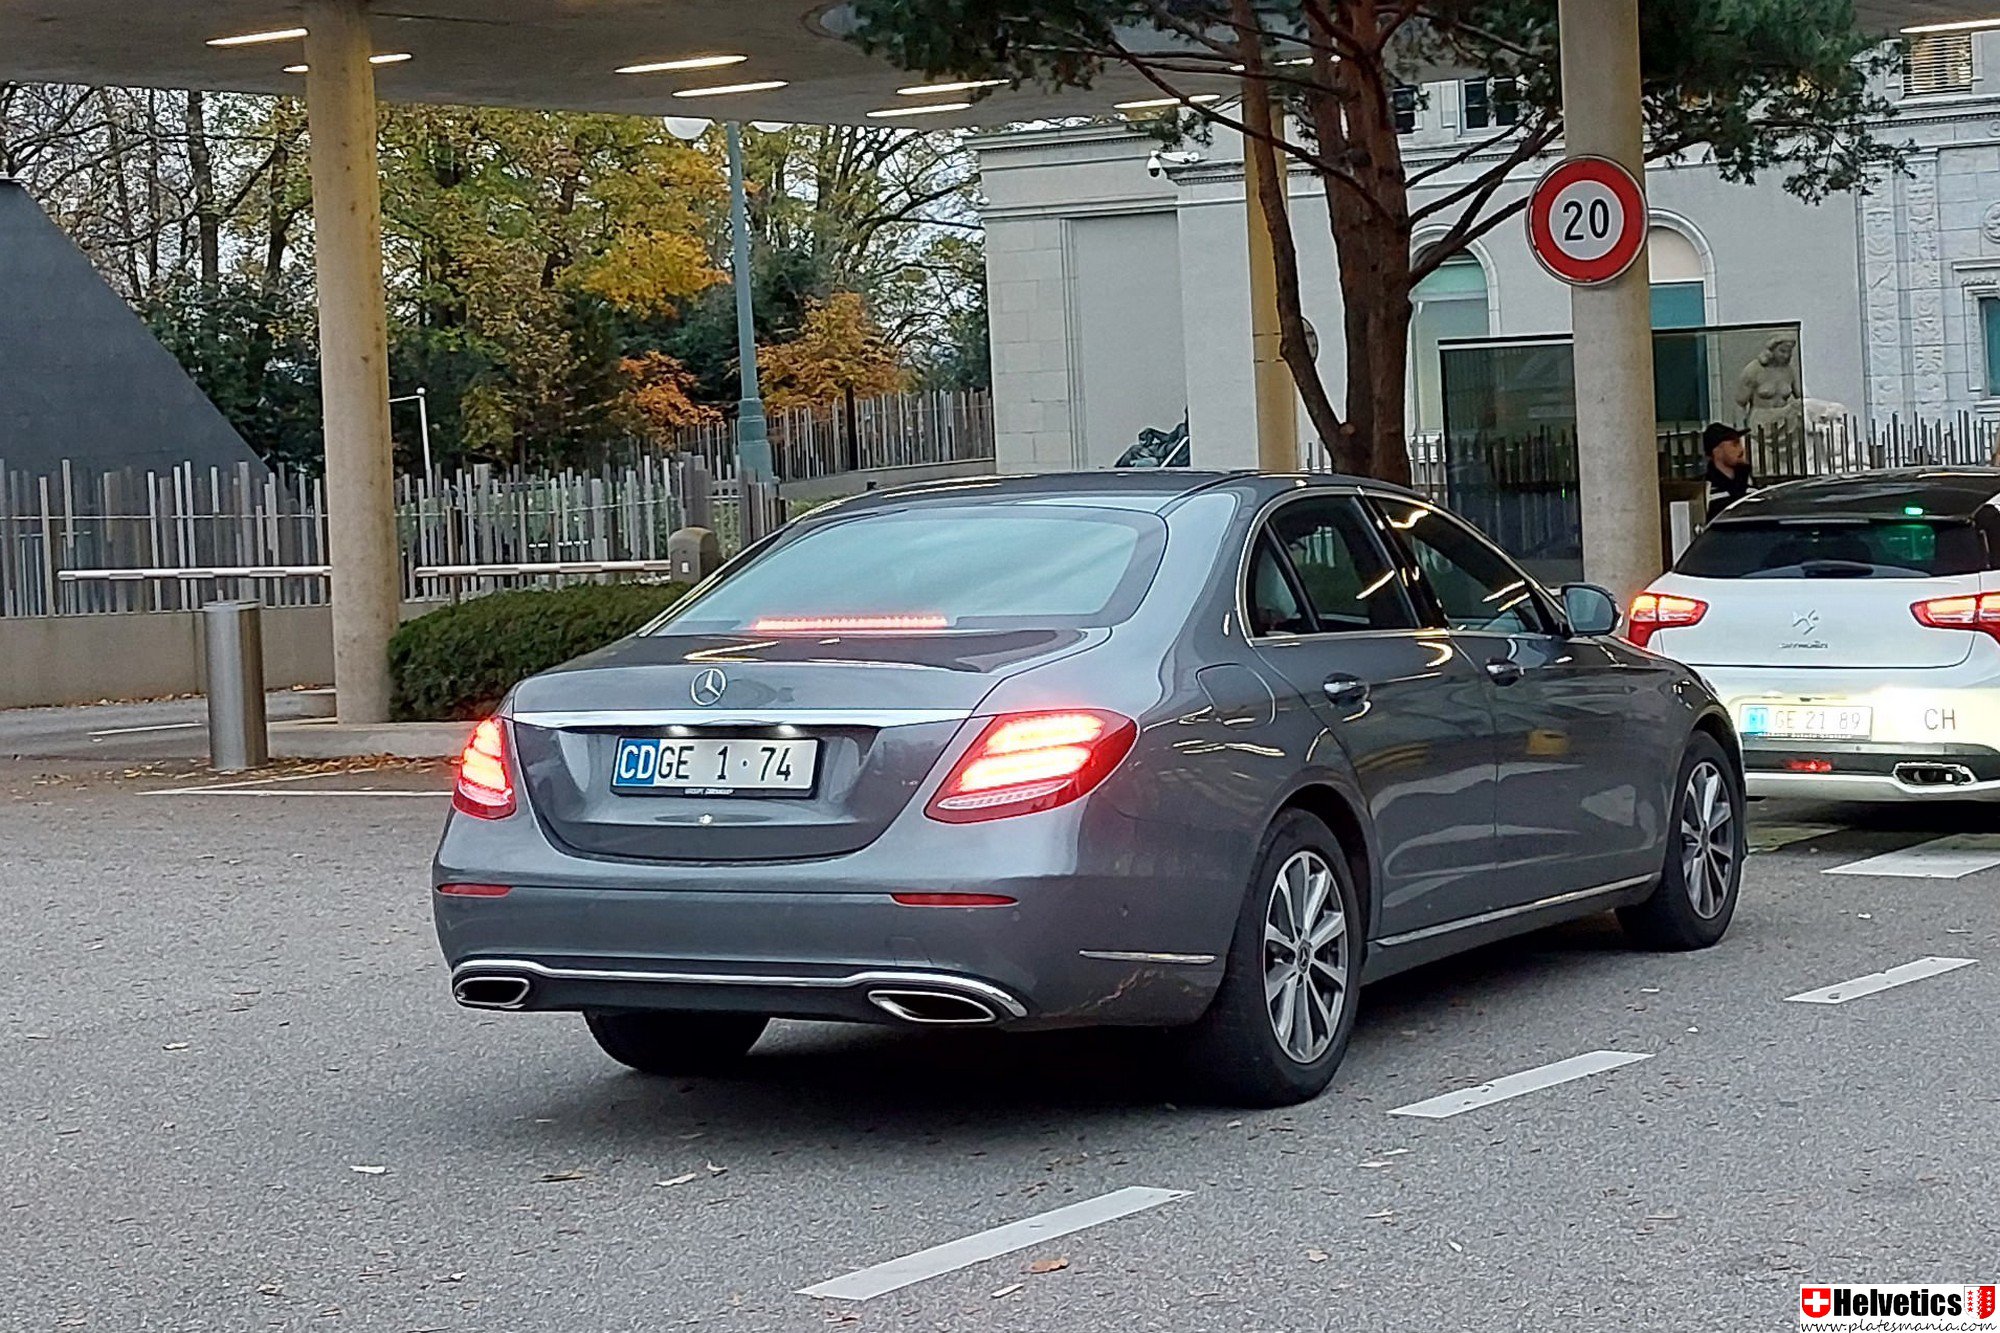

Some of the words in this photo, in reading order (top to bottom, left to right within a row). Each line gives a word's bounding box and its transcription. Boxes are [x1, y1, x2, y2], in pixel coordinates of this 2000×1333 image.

[1563, 198, 1609, 241] 20
[1775, 710, 1797, 729] GE
[1806, 711, 1825, 729] 21
[1839, 712, 1861, 730] 89
[1924, 708, 1956, 731] CH
[619, 745, 656, 779] CD
[658, 745, 695, 780] GE
